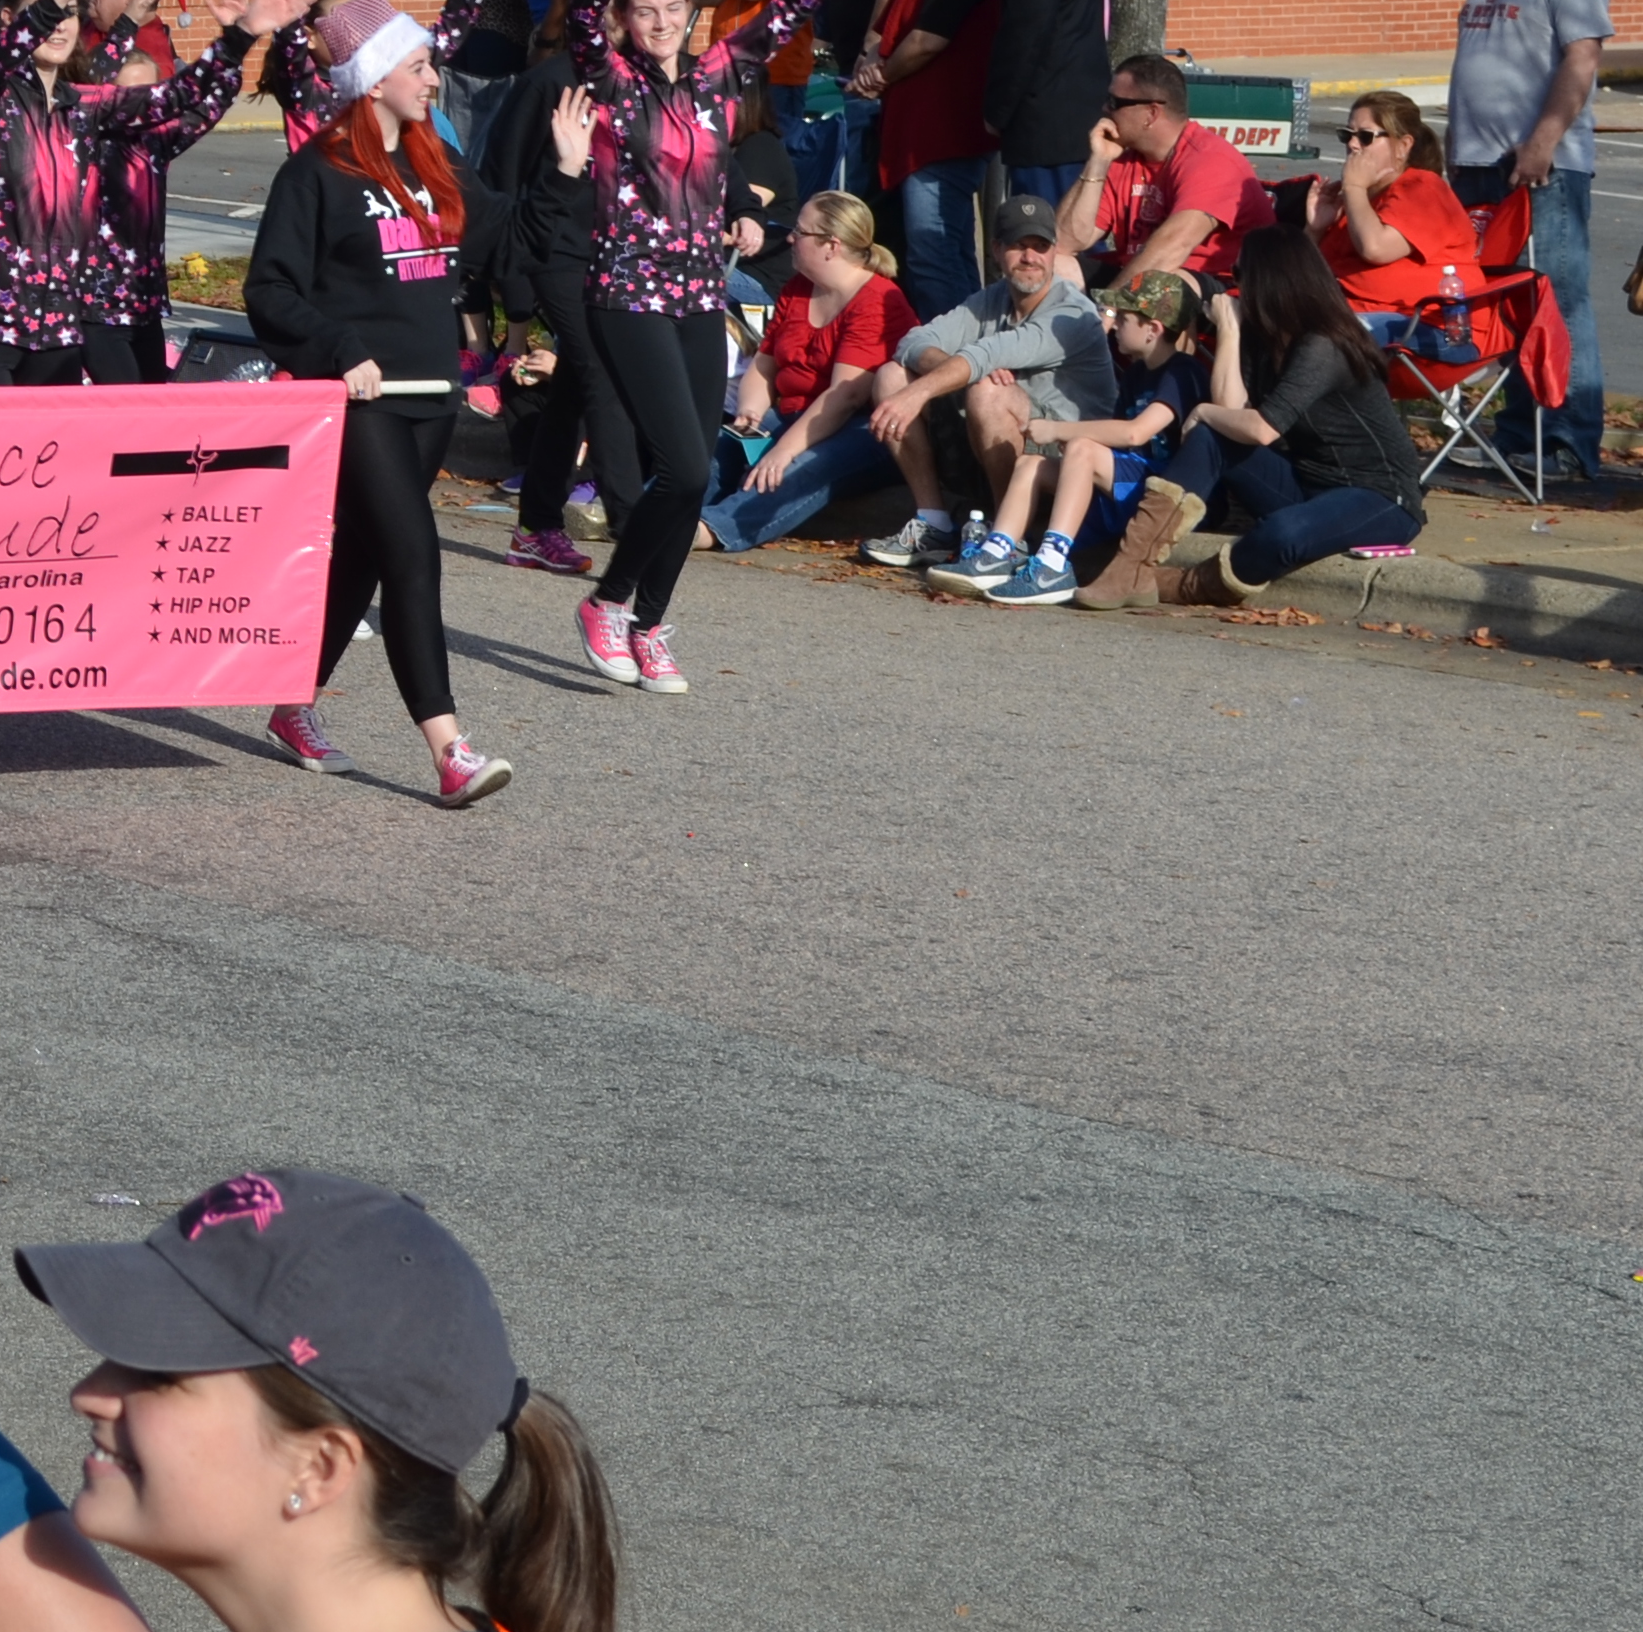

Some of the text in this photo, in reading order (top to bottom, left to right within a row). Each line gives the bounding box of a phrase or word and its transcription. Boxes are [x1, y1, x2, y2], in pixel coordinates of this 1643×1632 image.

[1232, 127, 1281, 147] DEPT
[182, 505, 263, 523] BALLET
[178, 535, 232, 553] JAZZ
[176, 567, 216, 584] TAP
[170, 596, 251, 614] HIP HOP
[169, 627, 297, 645] AND MORE...
